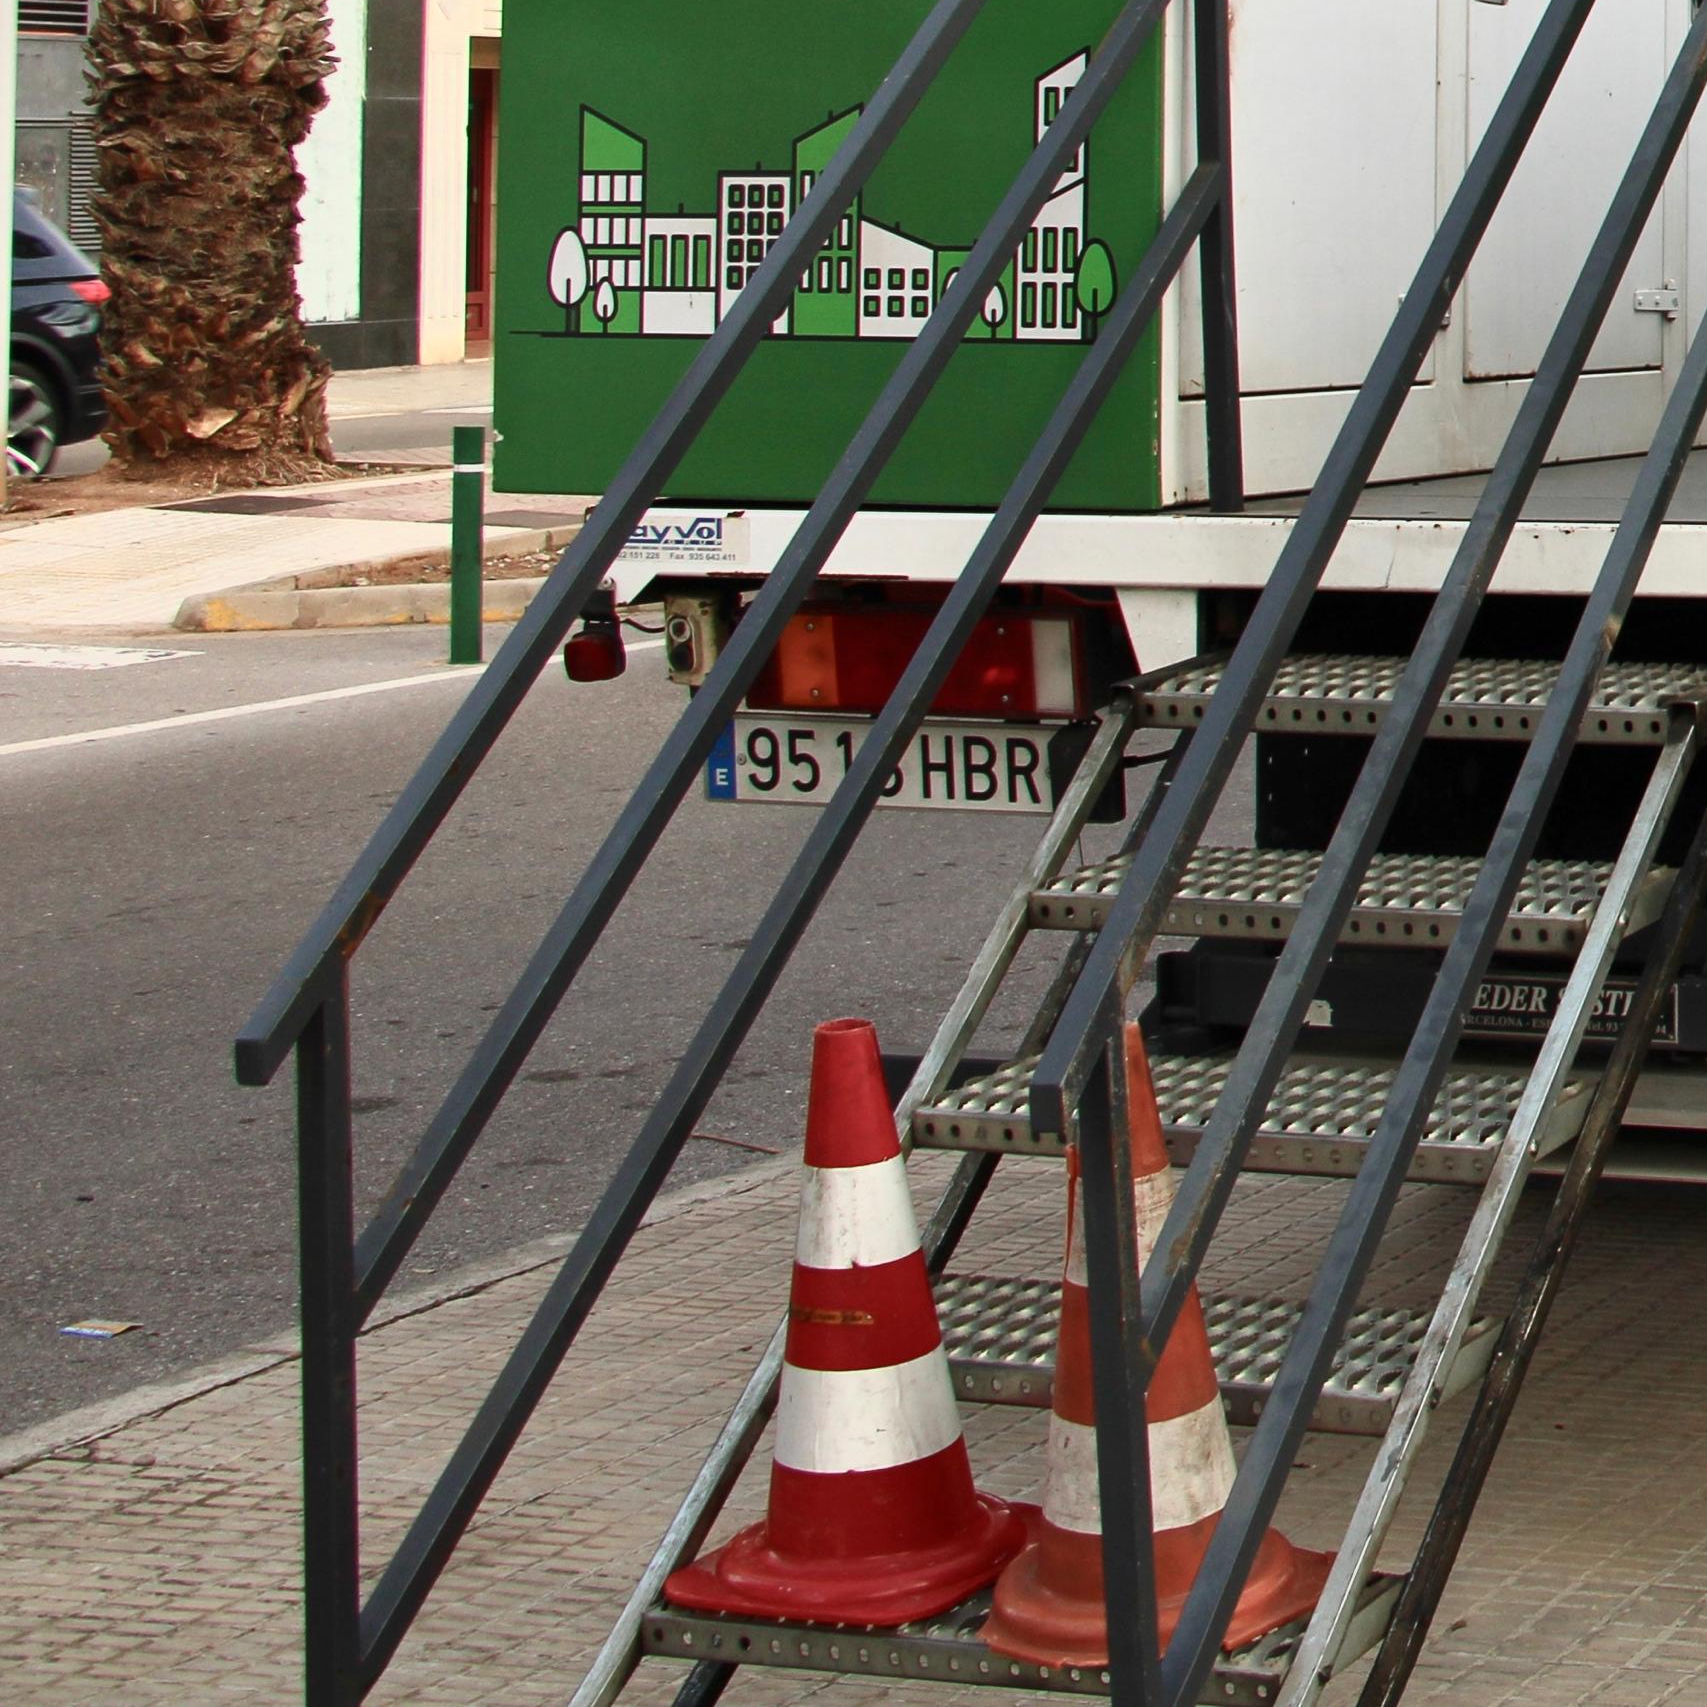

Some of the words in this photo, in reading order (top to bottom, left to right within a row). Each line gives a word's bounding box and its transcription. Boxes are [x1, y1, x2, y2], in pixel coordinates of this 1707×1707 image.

[669, 553, 685, 561] Fax
[716, 768, 729, 786] E
[921, 734, 1042, 804] HBR
